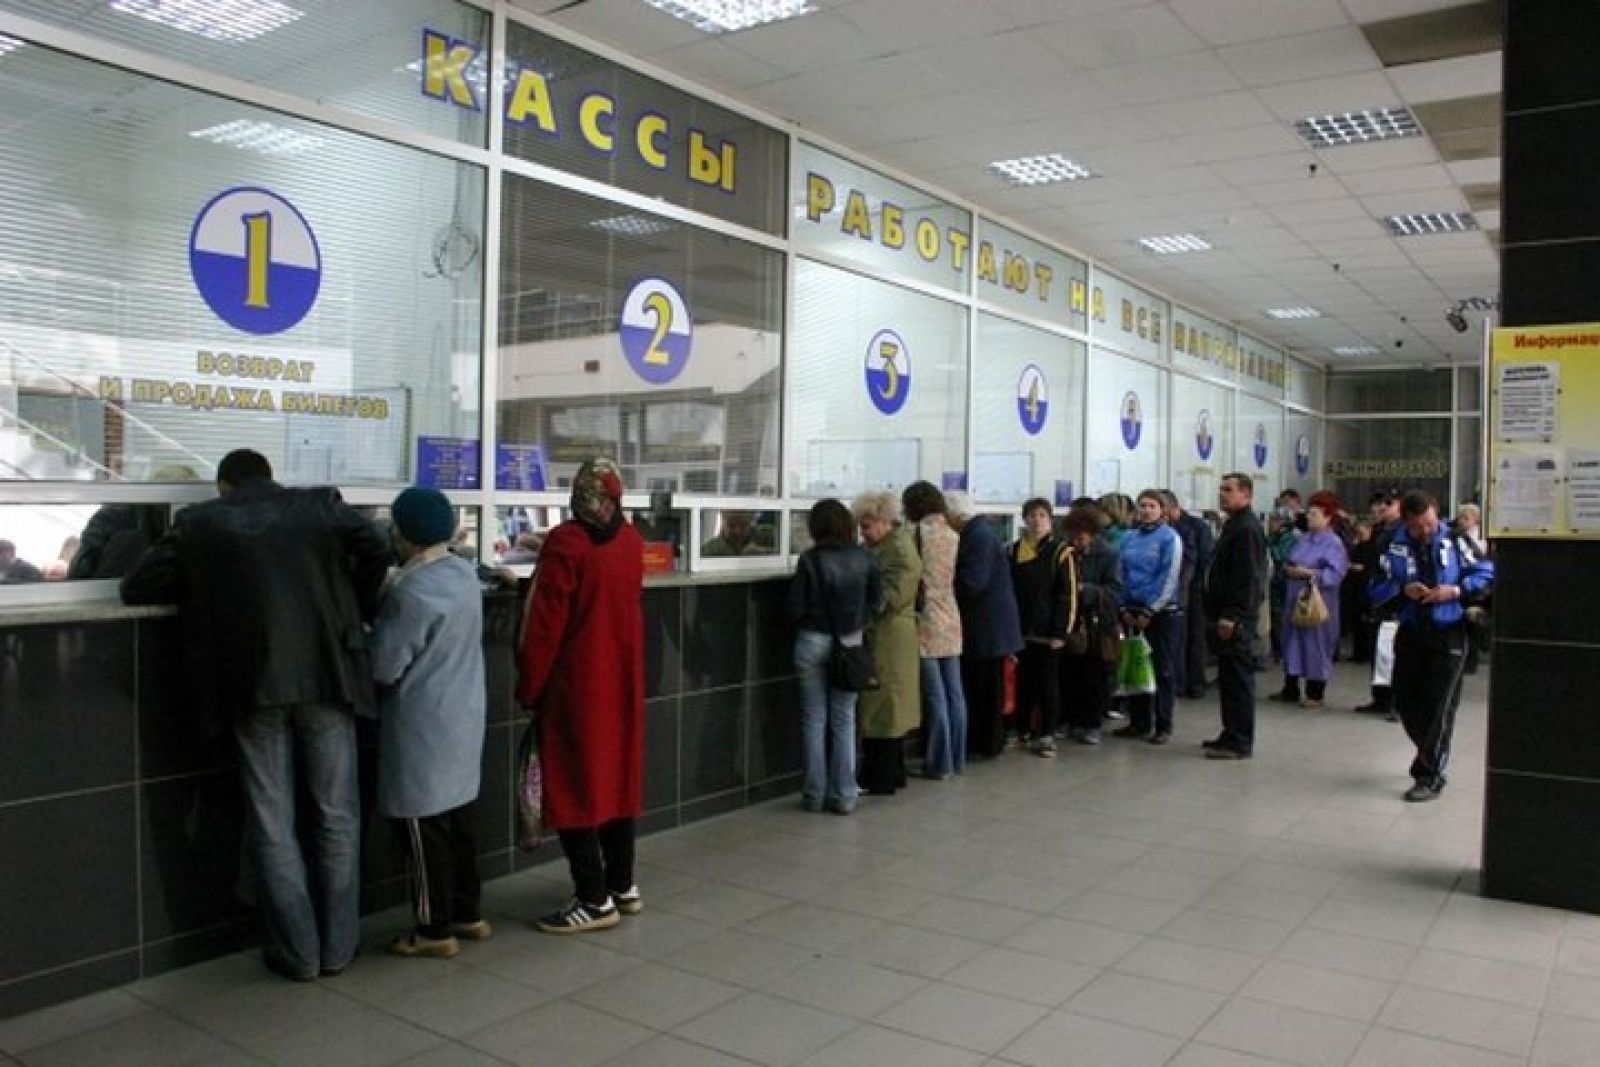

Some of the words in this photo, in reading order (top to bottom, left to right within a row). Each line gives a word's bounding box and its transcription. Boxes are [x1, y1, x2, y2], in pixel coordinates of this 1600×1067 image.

[422, 28, 737, 194] КАССЫ
[806, 171, 1053, 301] РАБОТАЮТ
[1068, 276, 1106, 323] НА
[240, 211, 272, 308] 1
[642, 291, 673, 366] 2
[99, 375, 123, 402] И
[131, 377, 275, 411] ПРОДАЖА
[197, 350, 315, 383] ВОЗВРАТ
[878, 341, 899, 400] 3
